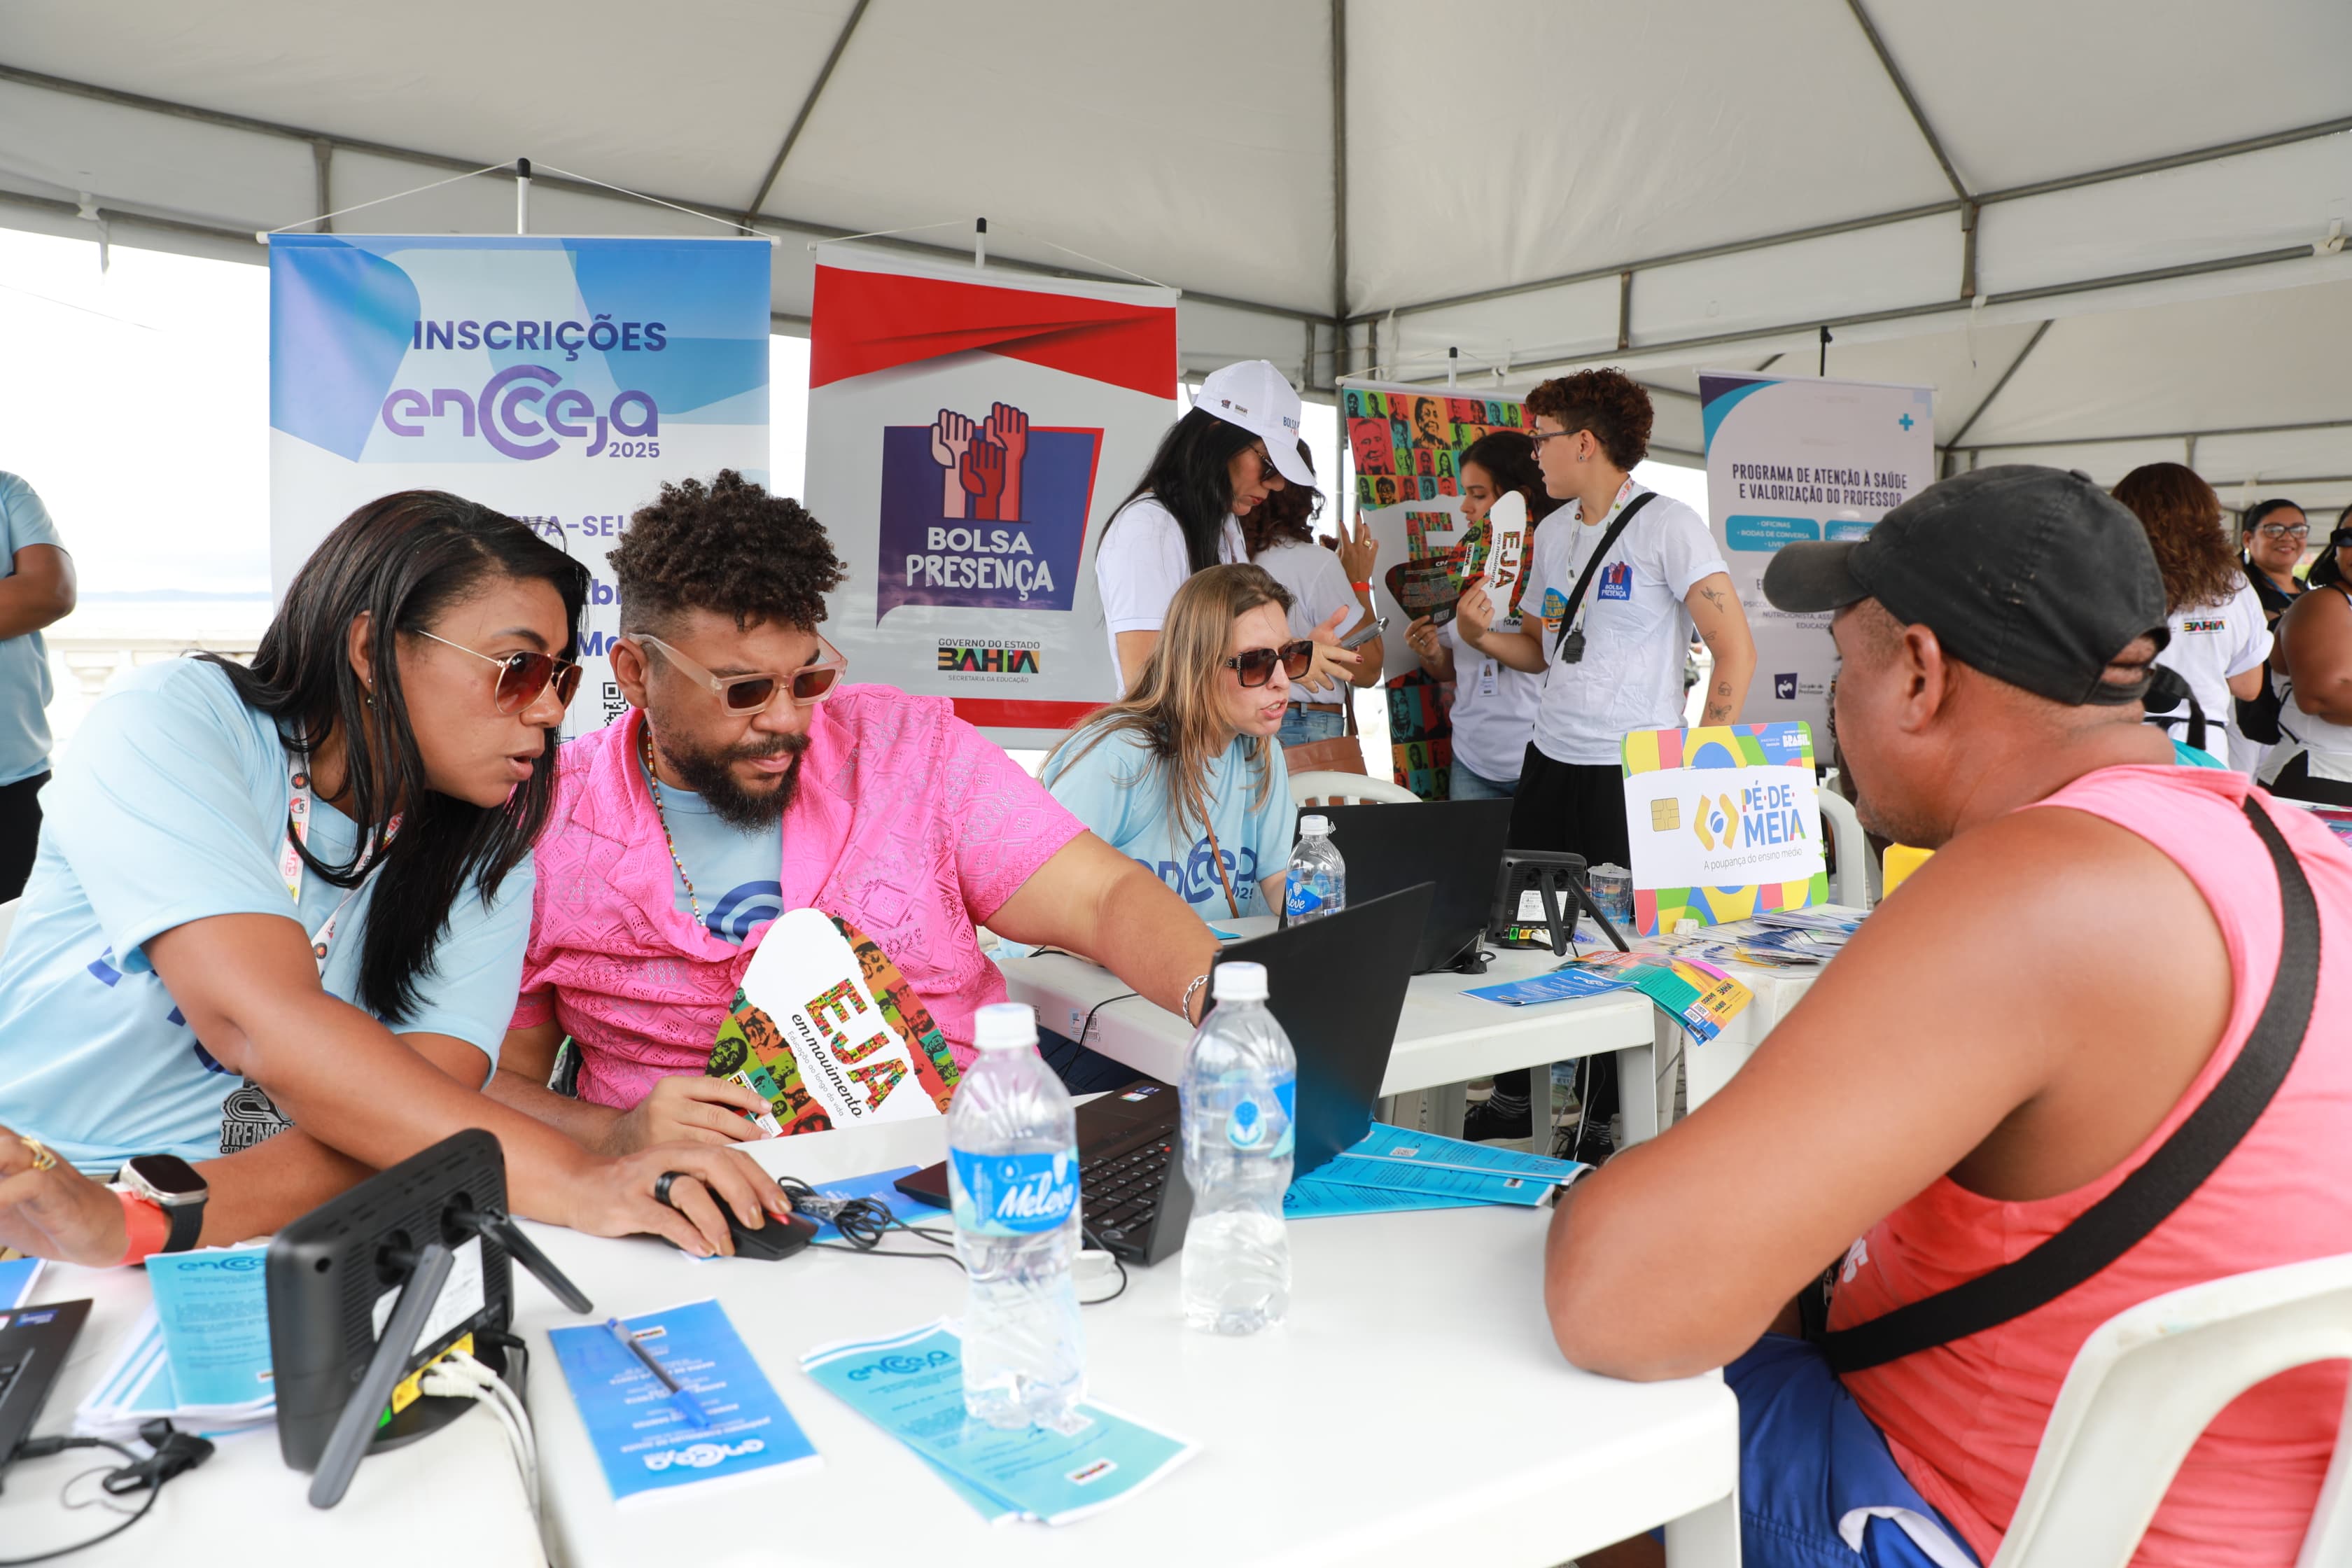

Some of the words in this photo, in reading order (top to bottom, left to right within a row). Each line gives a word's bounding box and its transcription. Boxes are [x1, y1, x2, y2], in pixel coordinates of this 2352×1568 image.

[413, 314, 667, 362] INSCRIÇÕES
[609, 441, 661, 459] 2025
[1732, 463, 1793, 482] PROGRAMA
[1798, 468, 1810, 484] DE
[1814, 468, 1860, 487] ATENÇÃO
[1864, 469, 1870, 487] À
[1874, 471, 1908, 489] SAÚDE
[1740, 483, 1746, 498] E
[1750, 483, 1823, 504] VALORIZAÇÃO
[1827, 489, 1840, 503] DO
[1844, 491, 1902, 507] PROFESSOR
[927, 527, 1033, 555] BOLSA
[1495, 531, 1520, 589] EJA
[906, 554, 1054, 601] PRESENÇA
[938, 638, 986, 648] GOVERNO
[988, 640, 1002, 648] DO
[1004, 640, 1040, 650] ESTADO
[938, 647, 1040, 674] BAHIA
[1743, 808, 1807, 848] MEIA
[1704, 860, 1710, 871] A
[1711, 855, 1746, 872] poupança
[1747, 853, 1757, 864] do
[1758, 851, 1781, 862] ensino
[1782, 847, 1802, 858] médio
[804, 977, 909, 1113] EJA
[787, 1030, 811, 1067] Educação
[808, 1063, 817, 1074] ao
[814, 1073, 830, 1094] longo
[826, 1090, 834, 1103] da
[833, 1100, 844, 1117] vida
[792, 1013, 811, 1039] em
[806, 1035, 863, 1119] movimento
